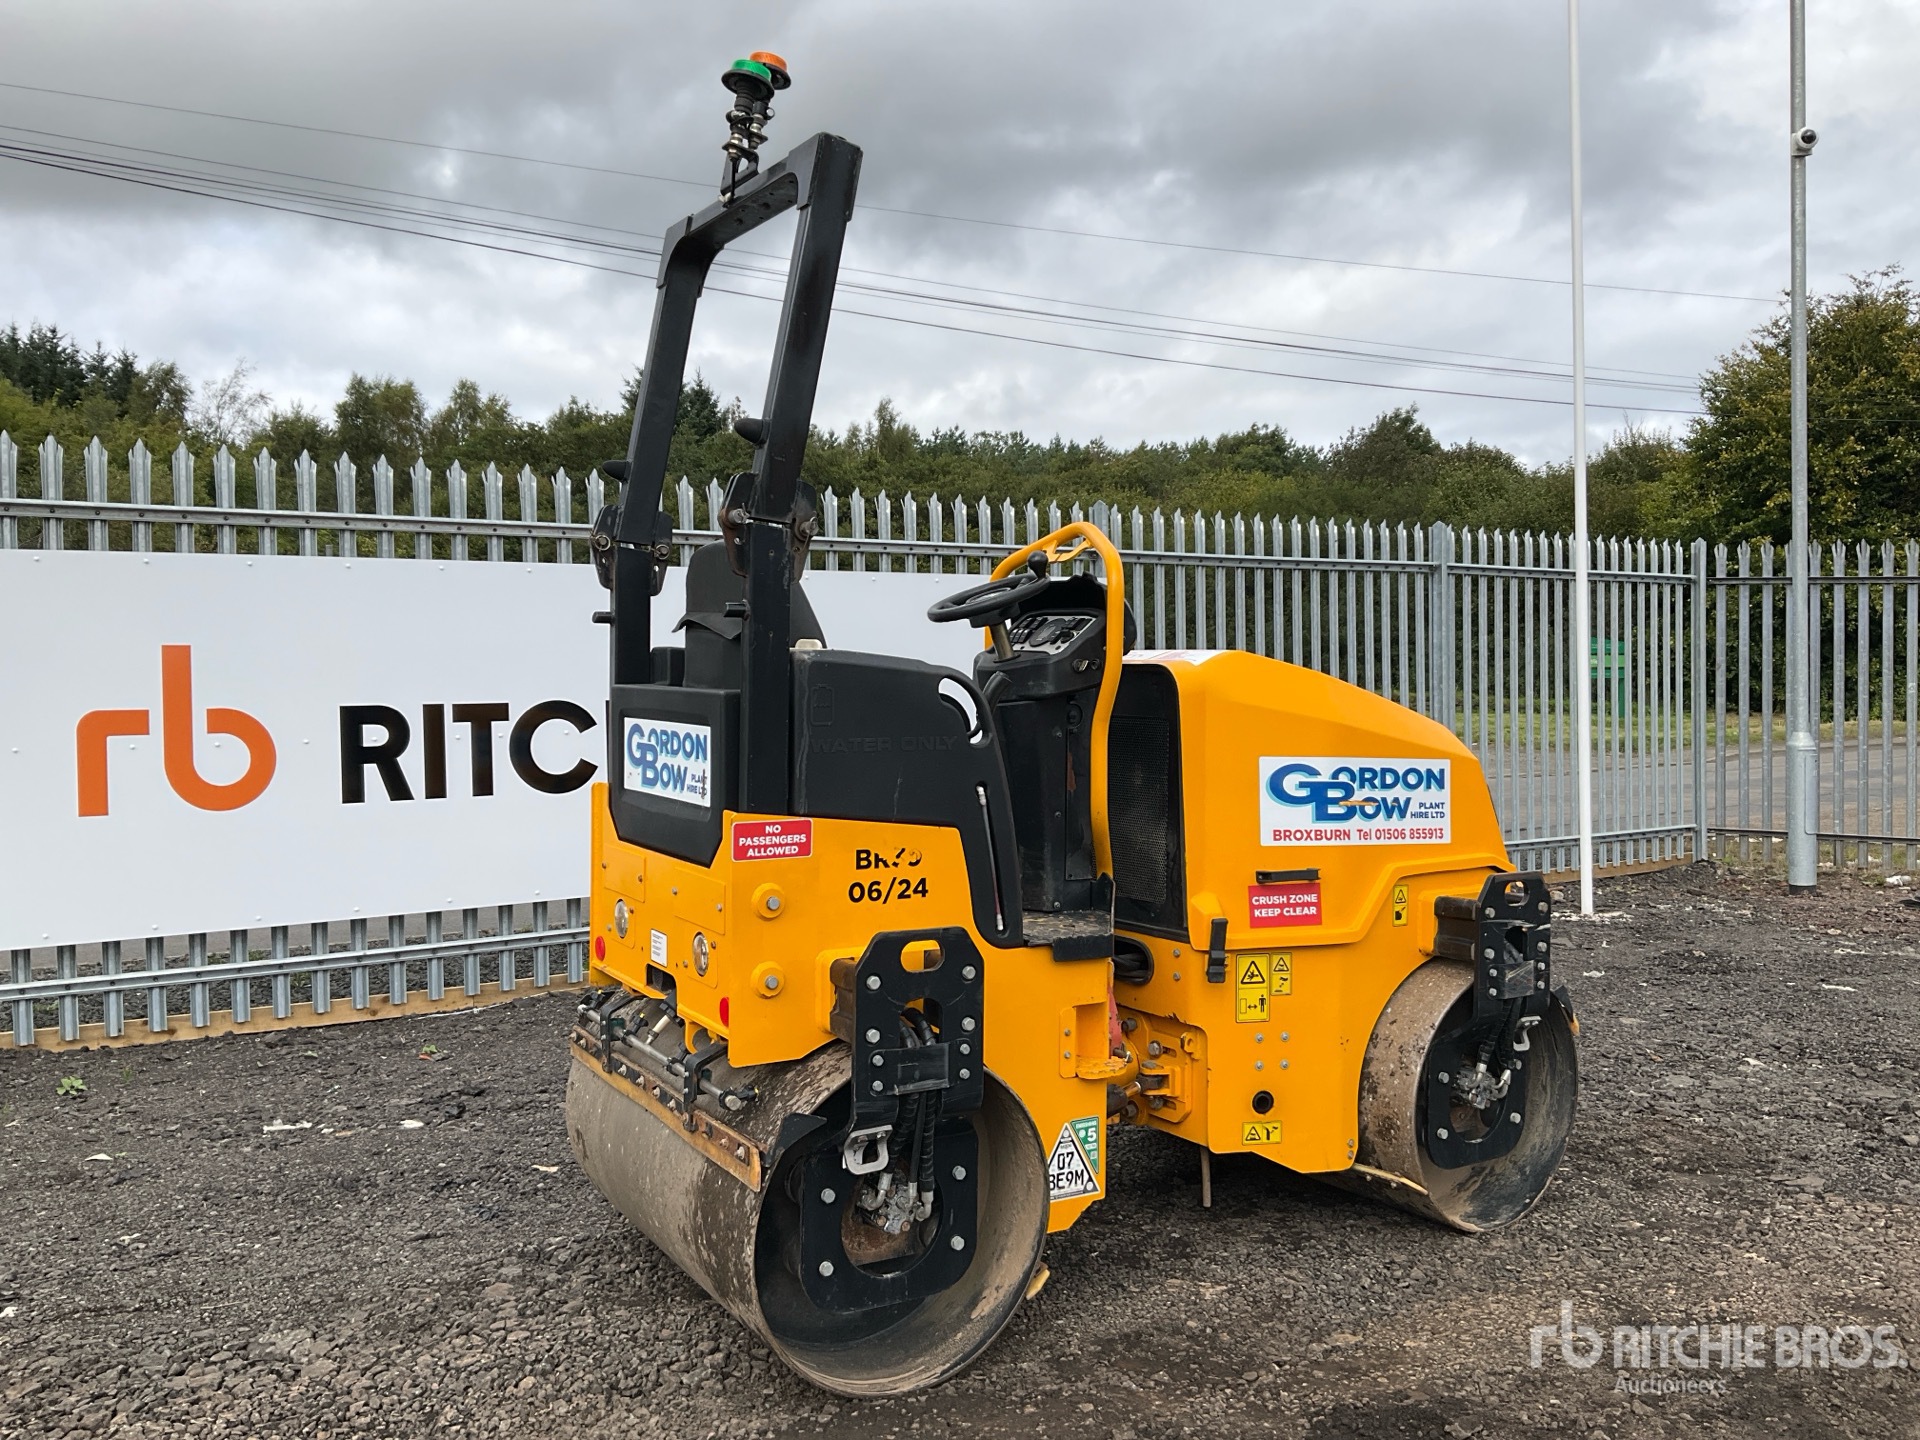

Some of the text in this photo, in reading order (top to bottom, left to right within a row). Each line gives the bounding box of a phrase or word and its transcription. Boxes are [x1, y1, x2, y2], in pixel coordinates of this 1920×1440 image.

[77, 645, 610, 817] rb RITC
[627, 723, 707, 767] GORDON
[811, 736, 957, 753] WATER ONLY
[641, 742, 688, 790] BOW
[1267, 763, 1445, 806] GORDON
[1300, 781, 1412, 822] BOW
[1418, 802, 1445, 810] PLANT
[1410, 811, 1445, 819] HIRE LTD
[765, 824, 782, 834] NO
[1272, 827, 1444, 842] BROXBURN Tel 01506 855913
[739, 834, 806, 846] PASSENGERS
[747, 845, 798, 857] ALLOWED
[848, 876, 928, 904] 06/24
[1252, 893, 1318, 905] CRUSH ZONE
[1254, 906, 1317, 917] KEEP CLEAR
[1087, 1127, 1097, 1142] 5
